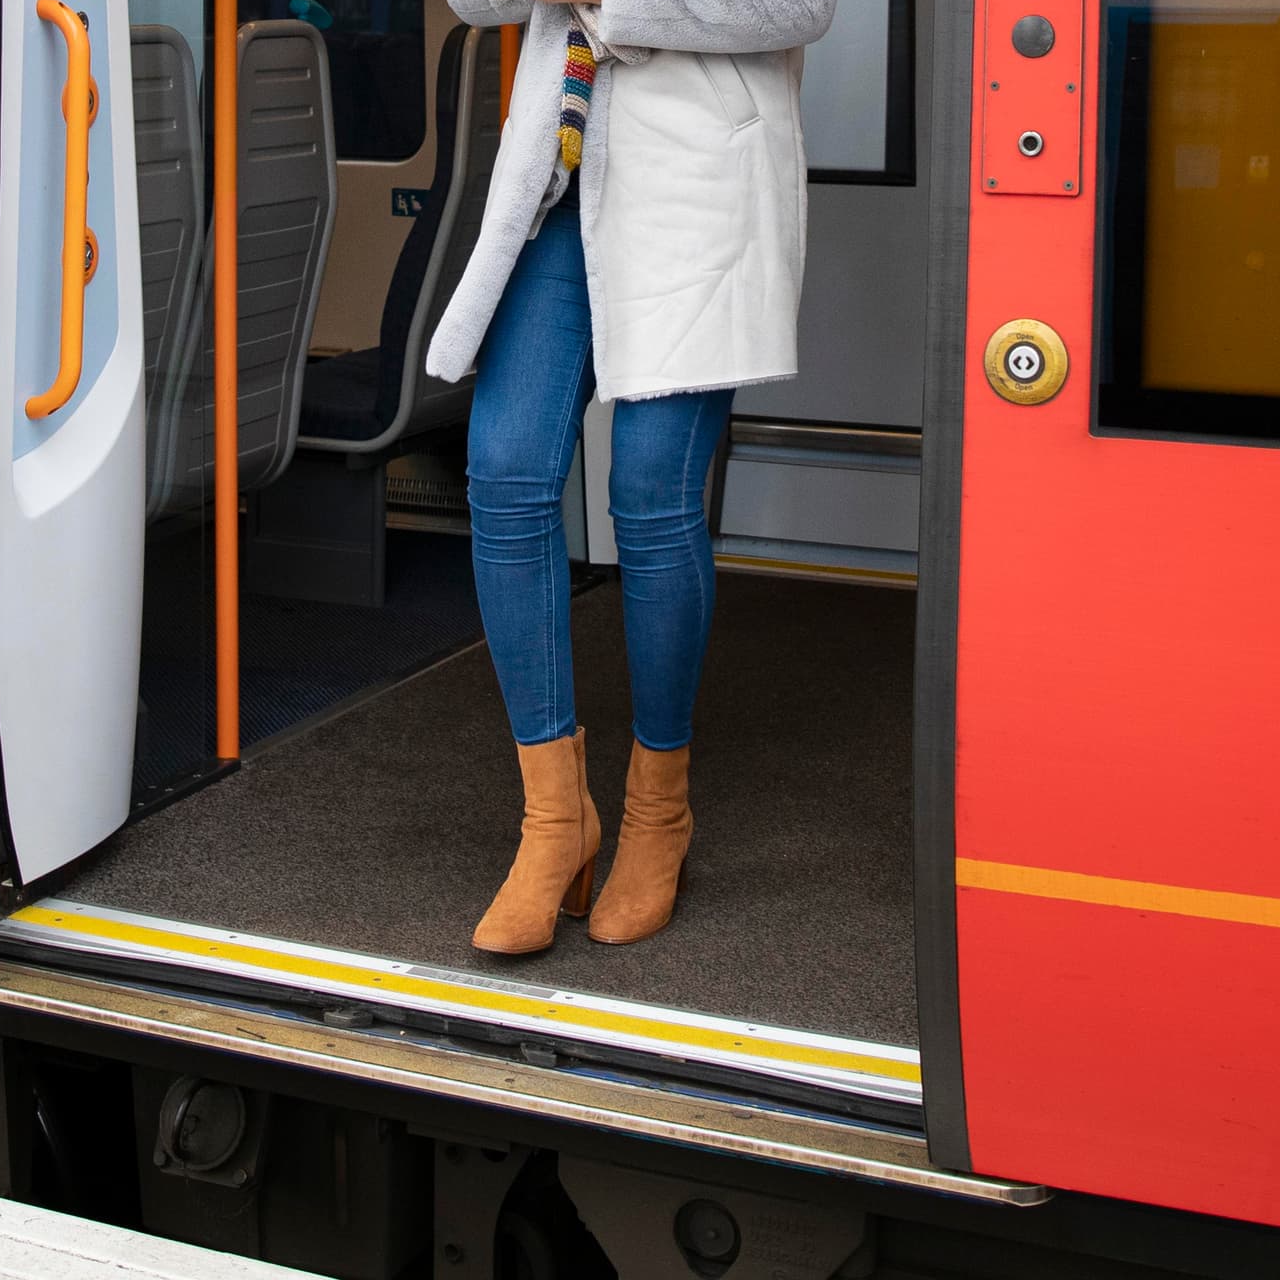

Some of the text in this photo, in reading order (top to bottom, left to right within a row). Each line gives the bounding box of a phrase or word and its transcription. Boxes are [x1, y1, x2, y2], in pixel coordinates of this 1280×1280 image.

[1015, 333, 1034, 341] Open
[1014, 383, 1033, 391] Open
[438, 971, 527, 995] SIEMENS
